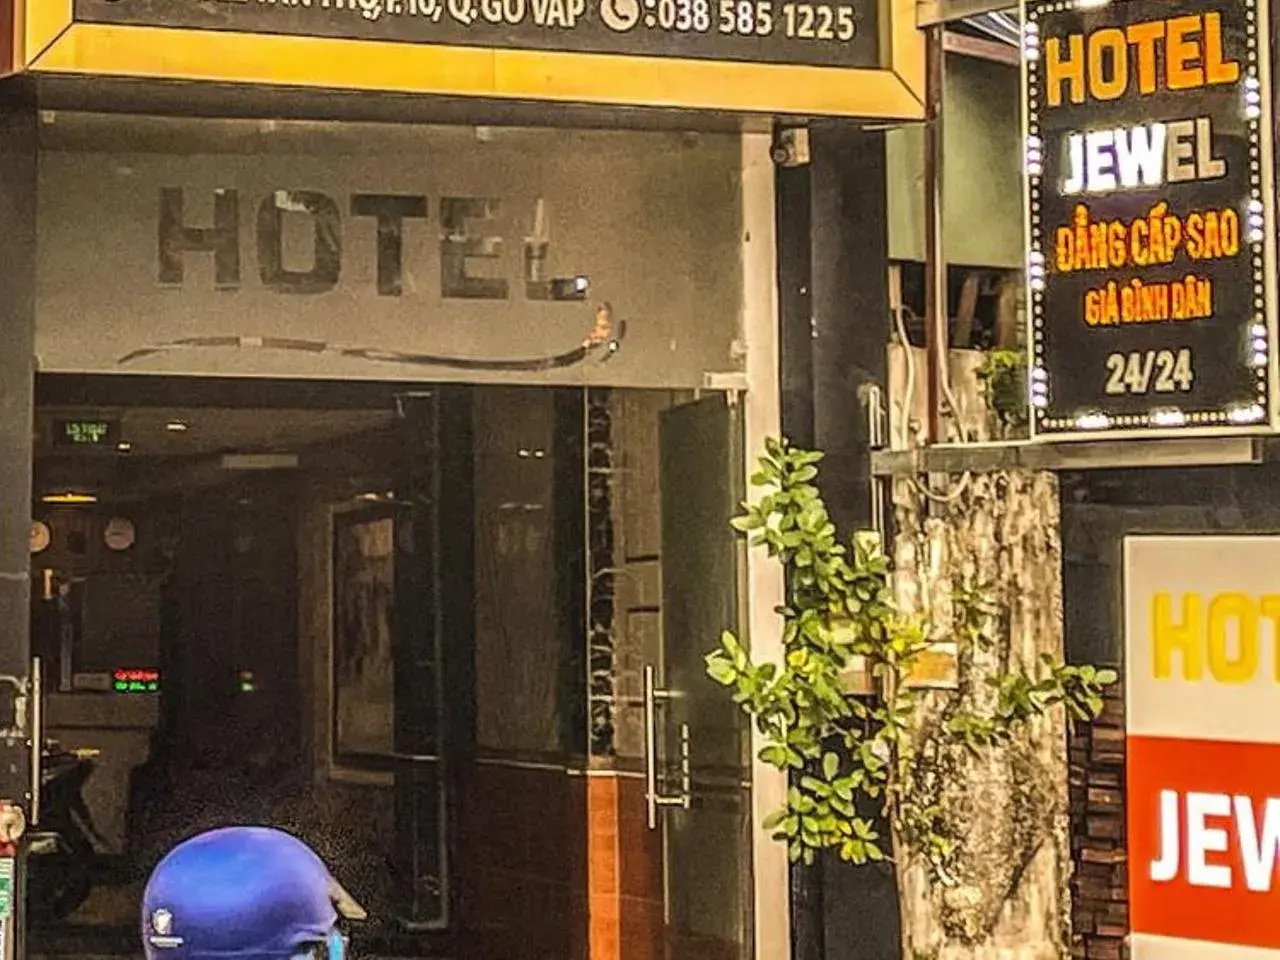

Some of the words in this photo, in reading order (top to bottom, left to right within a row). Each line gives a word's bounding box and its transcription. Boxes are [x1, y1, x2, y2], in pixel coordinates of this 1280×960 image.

[782, 1, 855, 42] 1225
[1045, 11, 1240, 107] HOTEL
[1061, 117, 1227, 196] JEWEL
[157, 185, 588, 300] HOTEL
[1185, 208, 1240, 259] SAO
[1105, 348, 1194, 394] 24/24
